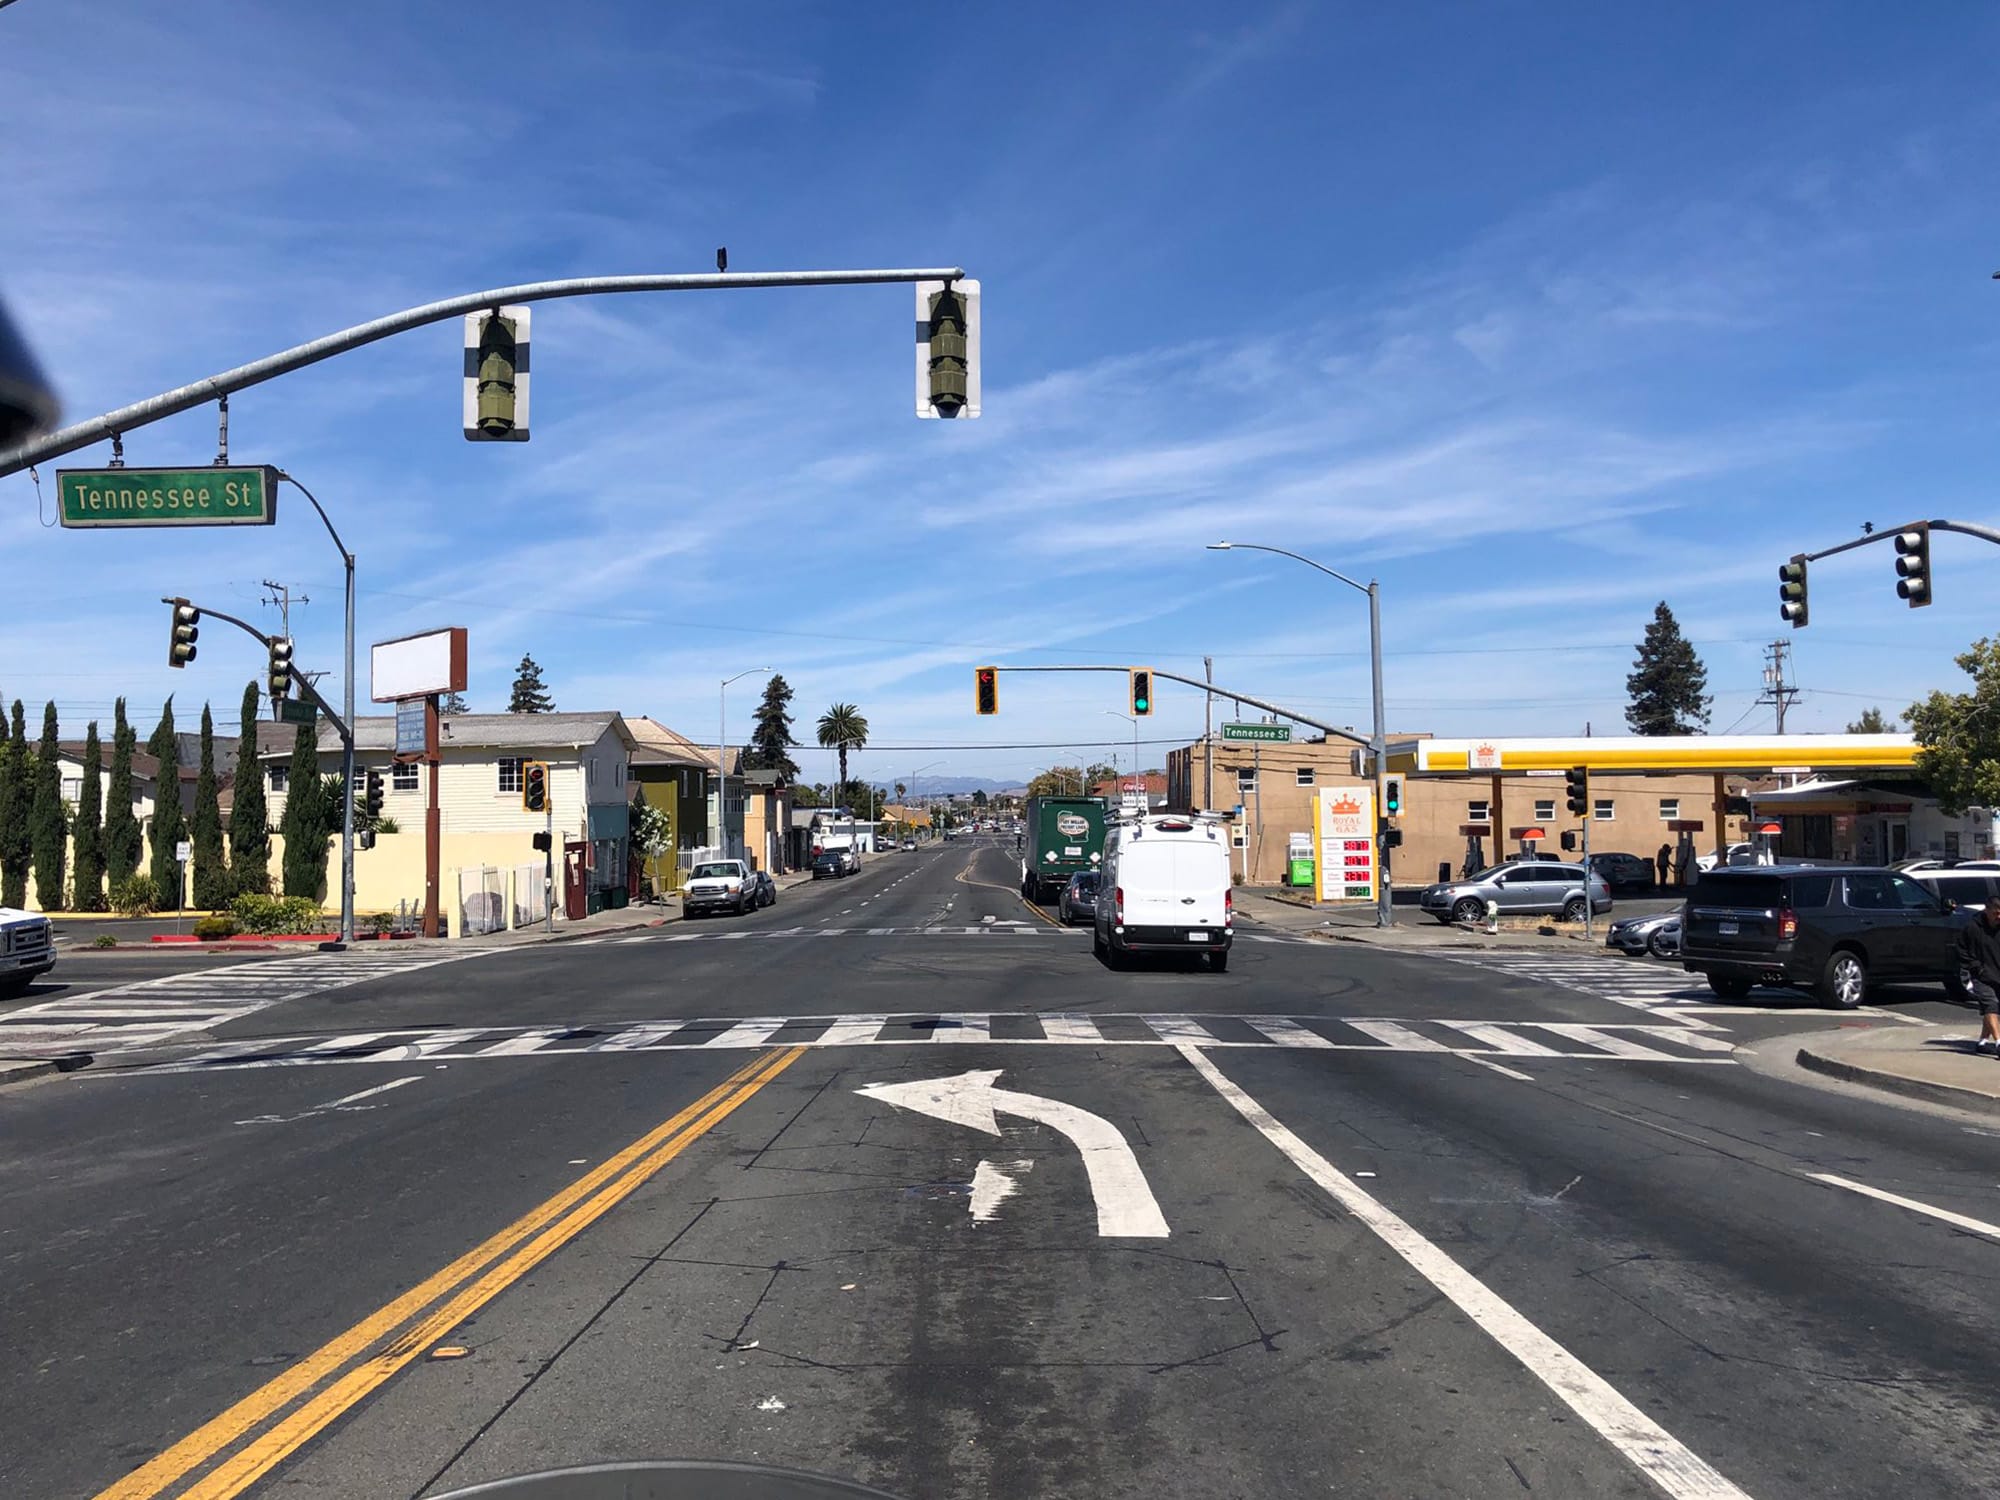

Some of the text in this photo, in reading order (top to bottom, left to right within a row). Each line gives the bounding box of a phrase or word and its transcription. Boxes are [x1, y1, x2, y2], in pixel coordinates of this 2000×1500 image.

[75, 482, 252, 510] Tennessee St
[1226, 727, 1288, 739] Tennessee St
[1333, 816, 1361, 824] ROYAL
